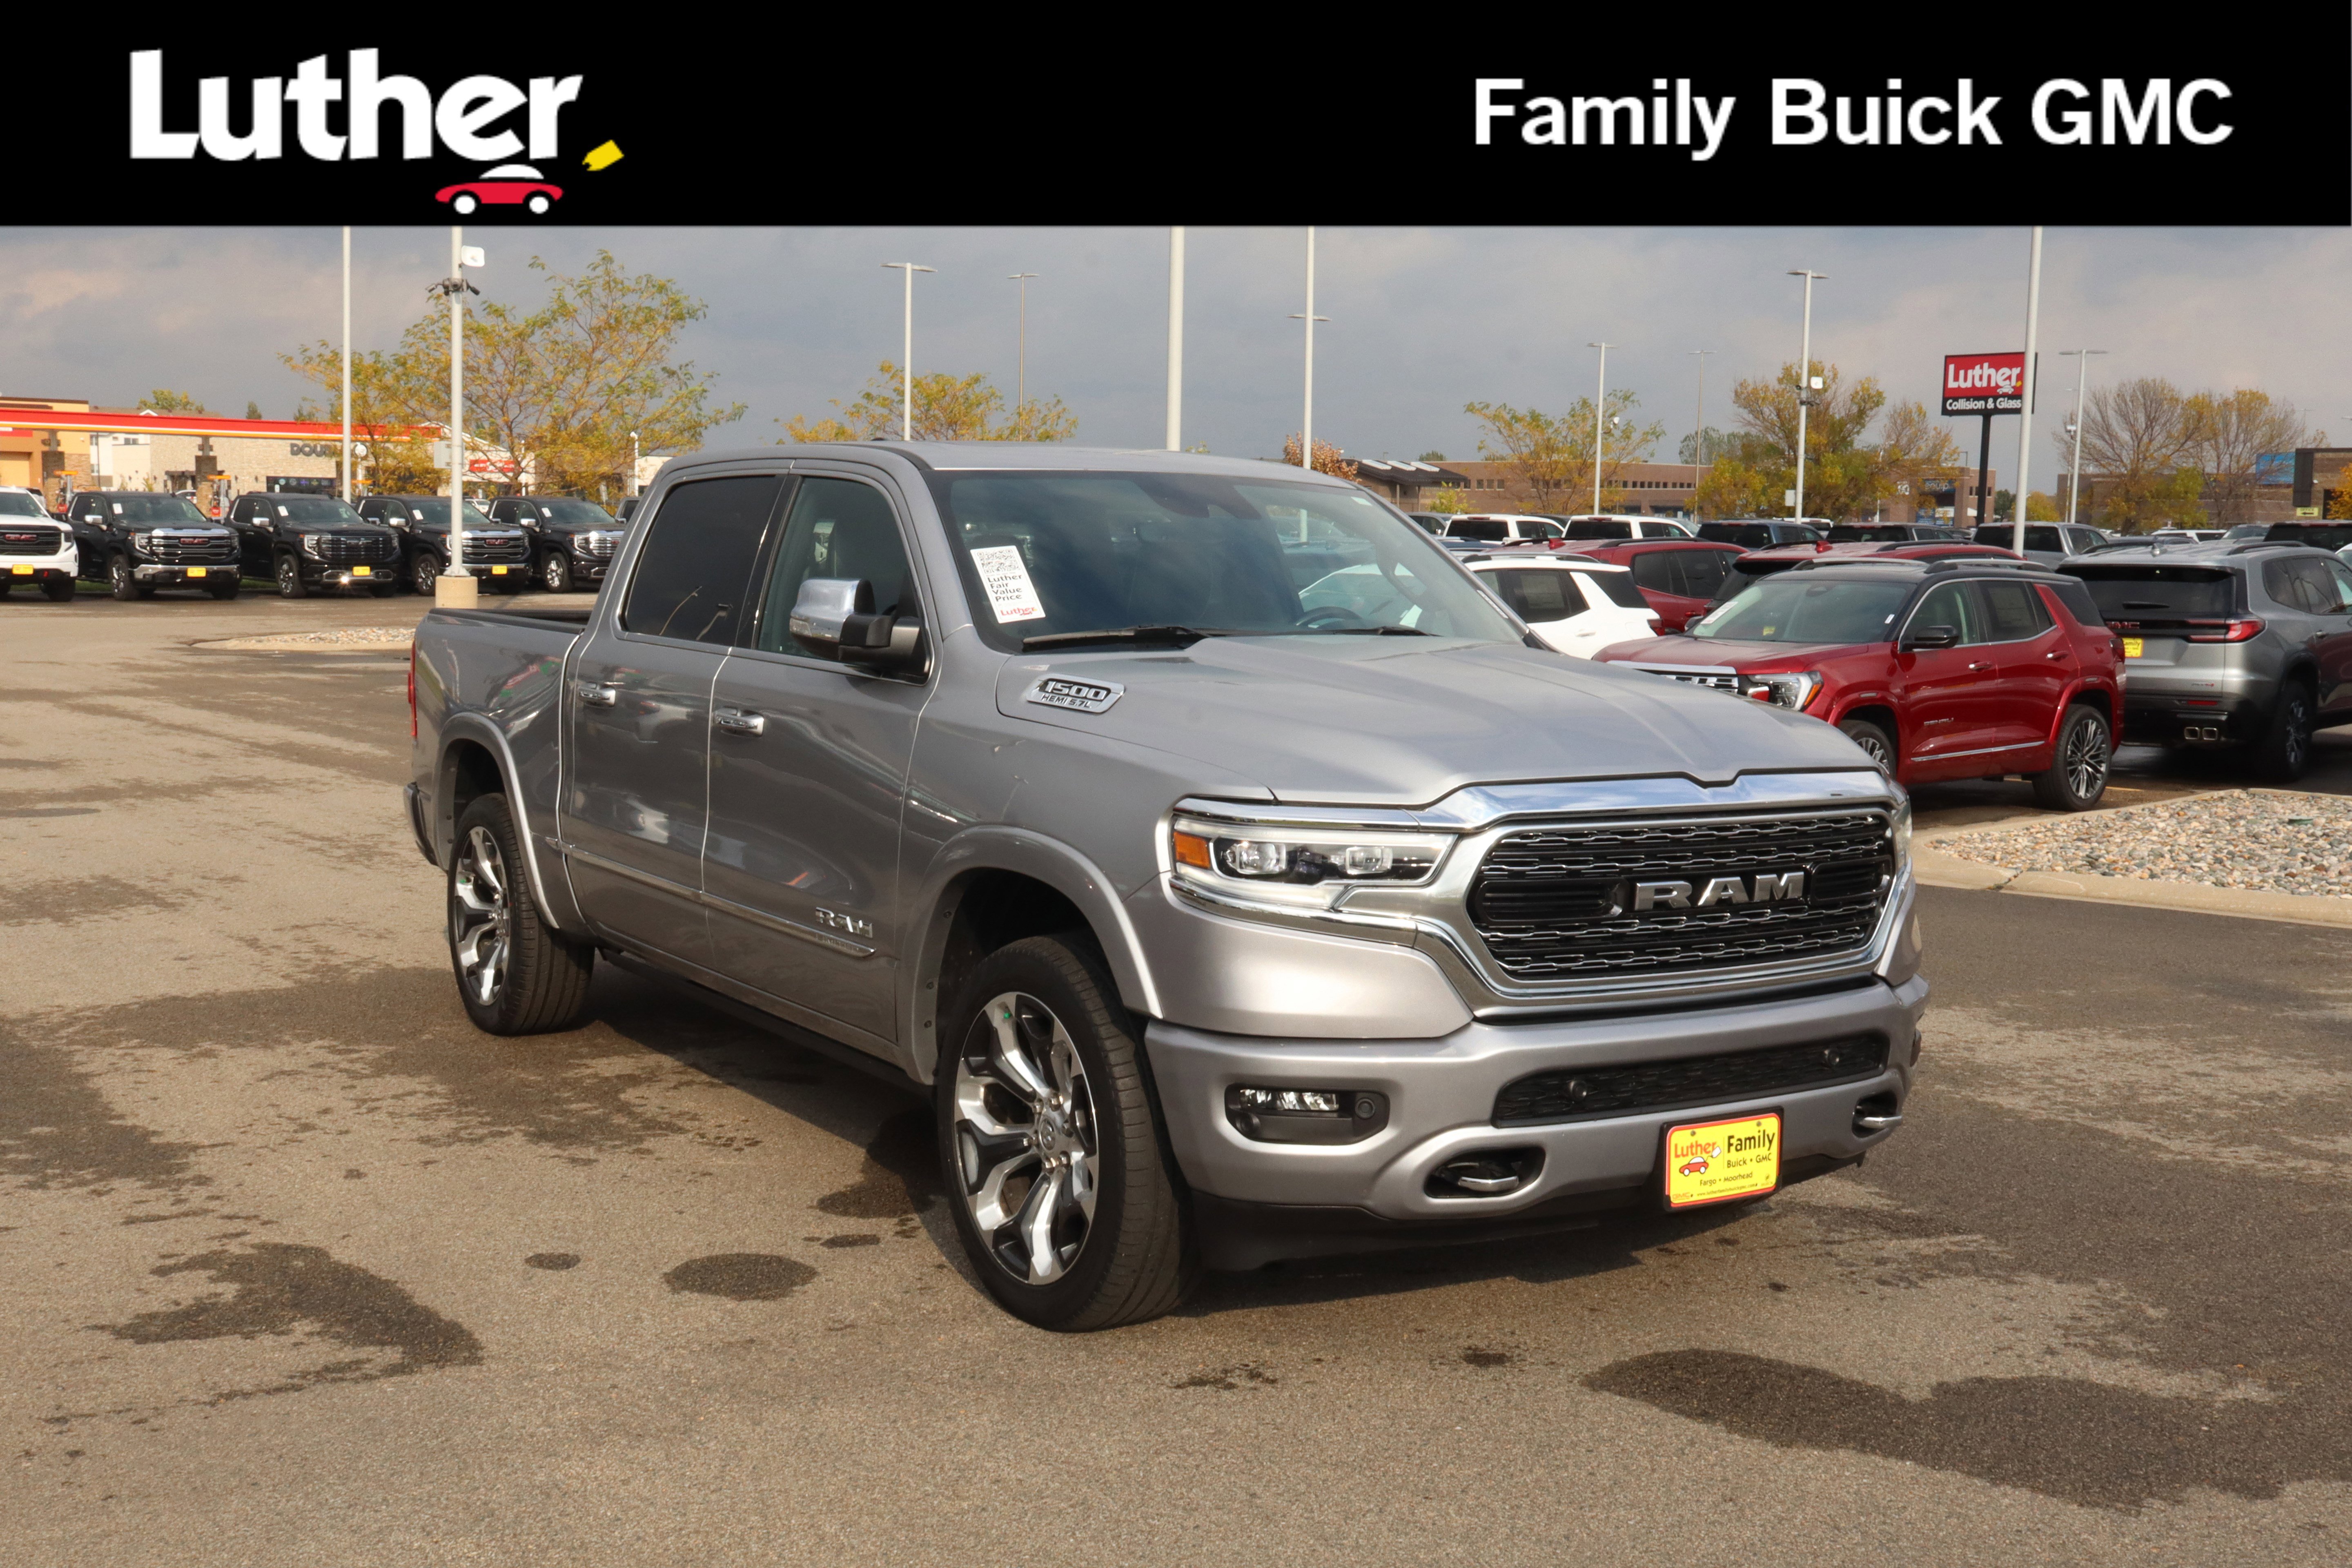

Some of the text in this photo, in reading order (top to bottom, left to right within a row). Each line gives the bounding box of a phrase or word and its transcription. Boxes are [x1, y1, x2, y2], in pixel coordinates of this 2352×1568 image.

[1948, 362, 2021, 388] Luther
[1946, 397, 2022, 410] Collision & Glass
[987, 574, 1022, 583] Luther
[1000, 607, 1035, 616] Luther
[1045, 680, 1107, 701] 1500
[1041, 693, 1092, 708] HEMI 5.7L
[1635, 871, 1804, 911] RAM
[815, 906, 873, 939] RAM
[1674, 1140, 1717, 1158] Luther
[1727, 1129, 1775, 1154] Family
[1726, 1153, 1772, 1168] Buick GMC
[1723, 1172, 1753, 1183] Moorhead
